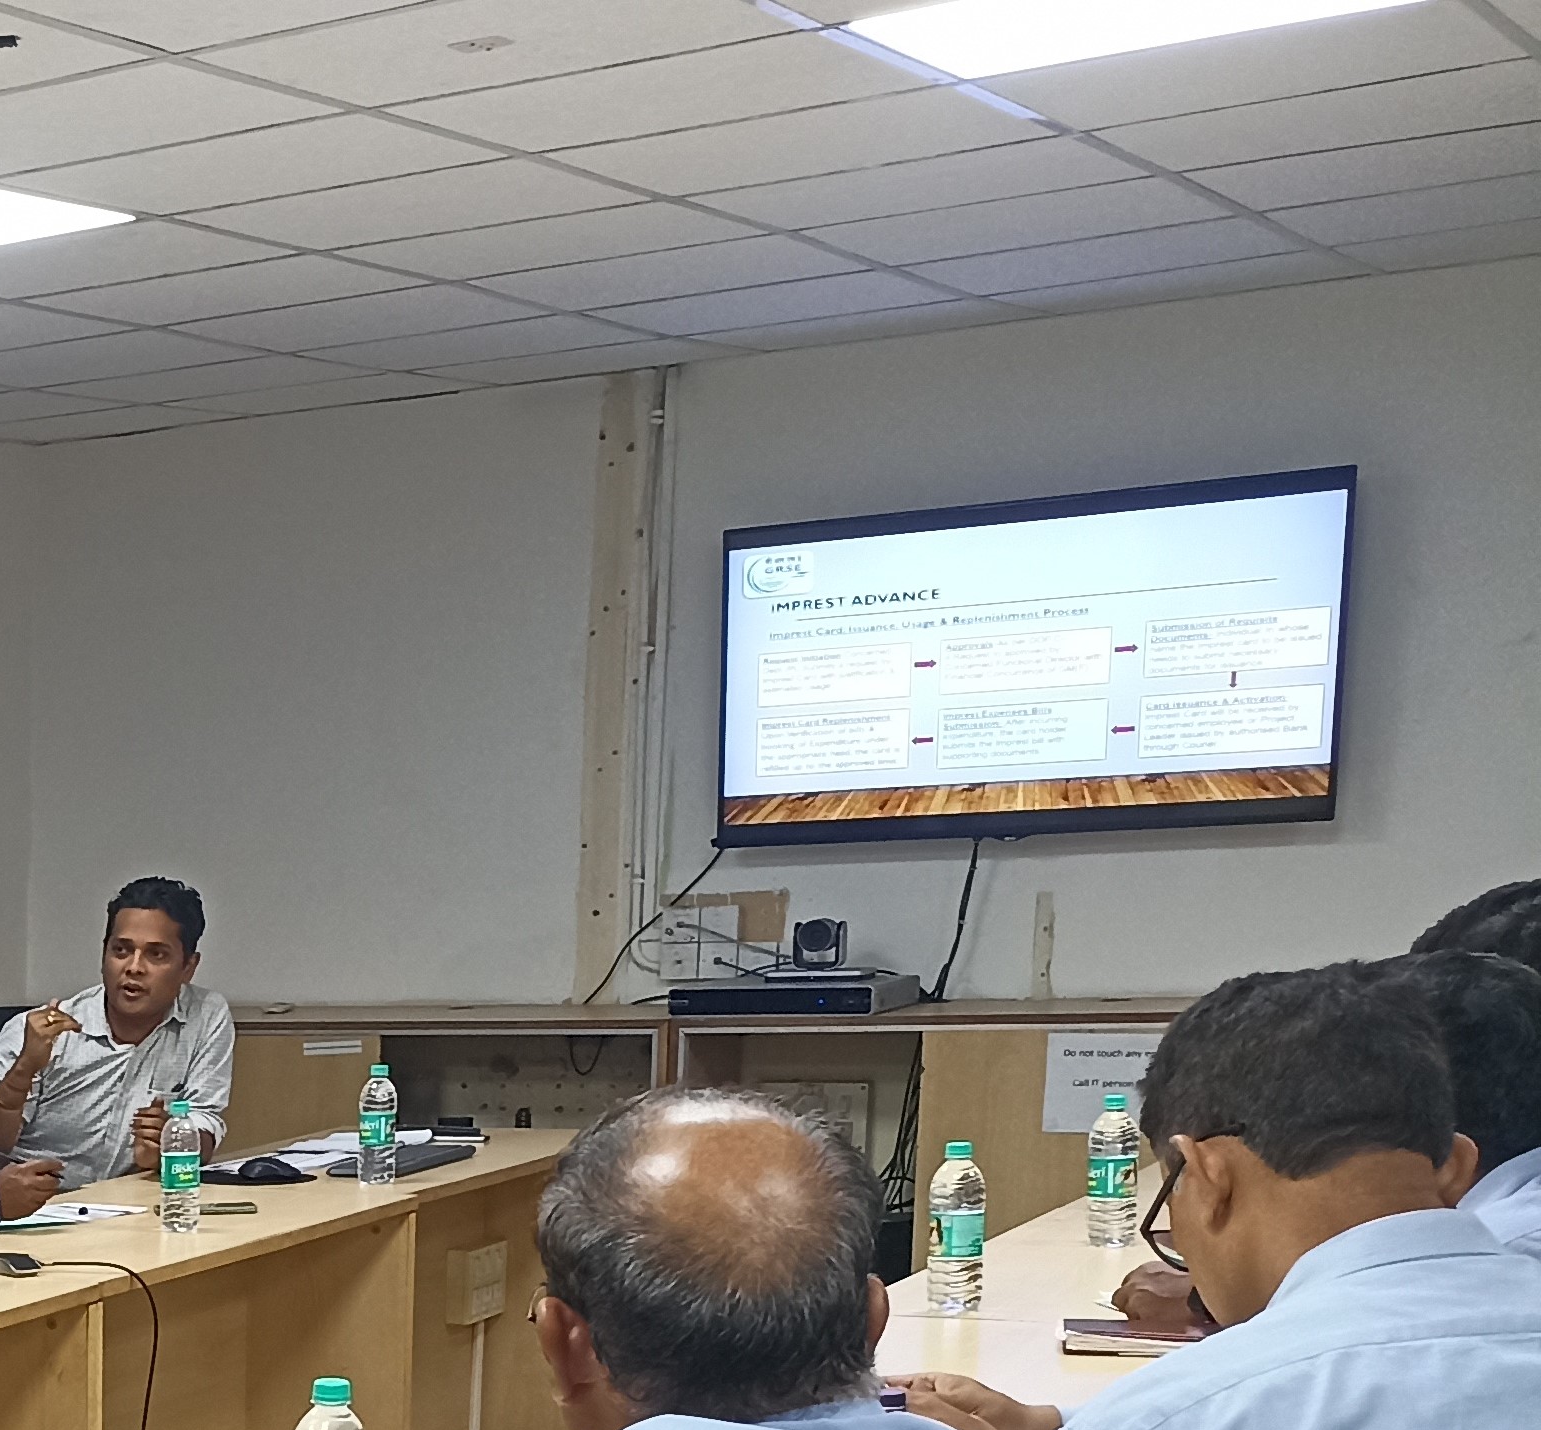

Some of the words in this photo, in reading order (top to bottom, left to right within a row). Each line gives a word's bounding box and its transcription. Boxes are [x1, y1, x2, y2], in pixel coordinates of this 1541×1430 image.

[771, 596, 846, 614] IMPREST
[851, 588, 941, 606] ADVANCE
[952, 610, 1039, 625] Replenishment
[1043, 606, 1089, 619] Process
[1063, 1049, 1077, 1058] Do
[1079, 1049, 1094, 1058] not
[1097, 1049, 1124, 1058] touch
[1125, 1050, 1143, 1059] any
[1073, 1079, 1090, 1087] Call
[1102, 1080, 1135, 1089] person
